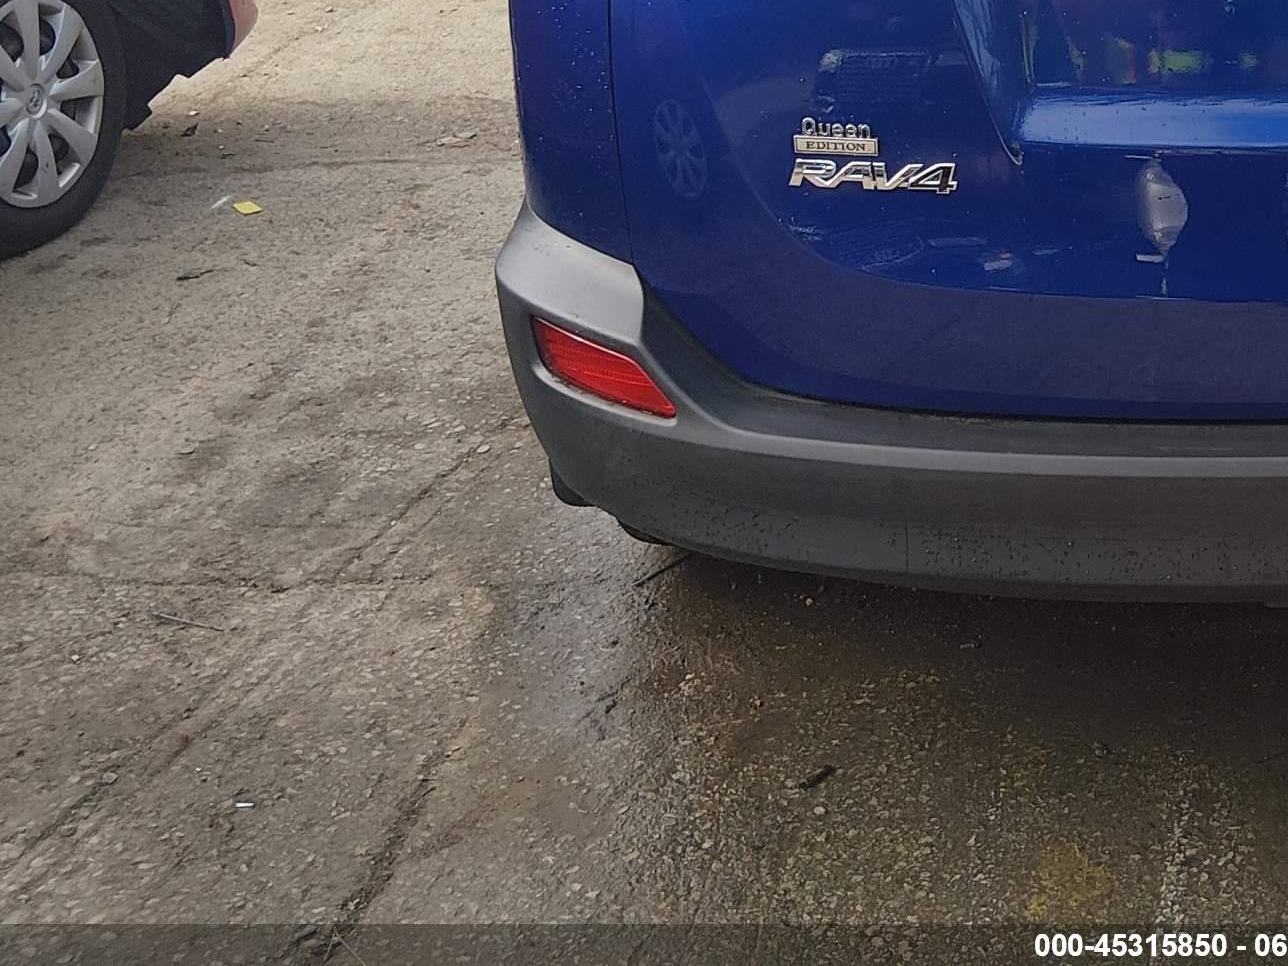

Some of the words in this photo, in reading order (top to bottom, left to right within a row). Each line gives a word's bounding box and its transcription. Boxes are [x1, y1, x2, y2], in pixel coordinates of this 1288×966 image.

[802, 117, 871, 139] Queen
[805, 140, 867, 152] EDITION
[788, 158, 958, 194] RAV4
